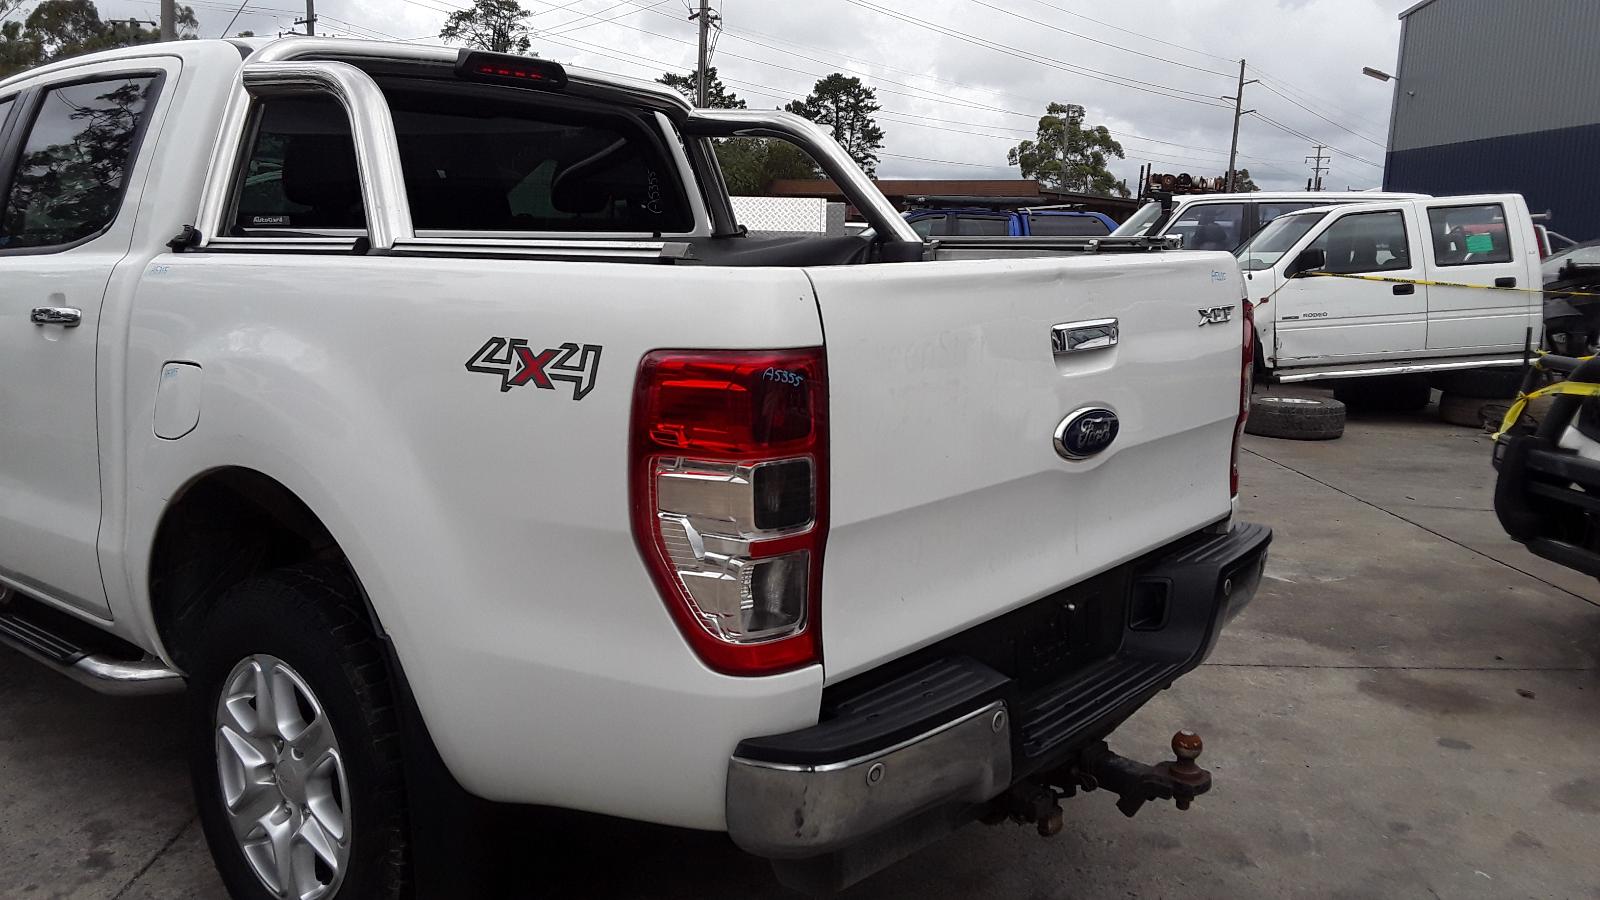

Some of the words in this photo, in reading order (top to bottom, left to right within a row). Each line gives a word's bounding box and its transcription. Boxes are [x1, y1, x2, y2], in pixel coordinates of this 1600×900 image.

[647, 168, 663, 214] A5355
[1197, 305, 1236, 327] XLT
[762, 366, 804, 387] A5355
[1078, 416, 1112, 447] Ford
